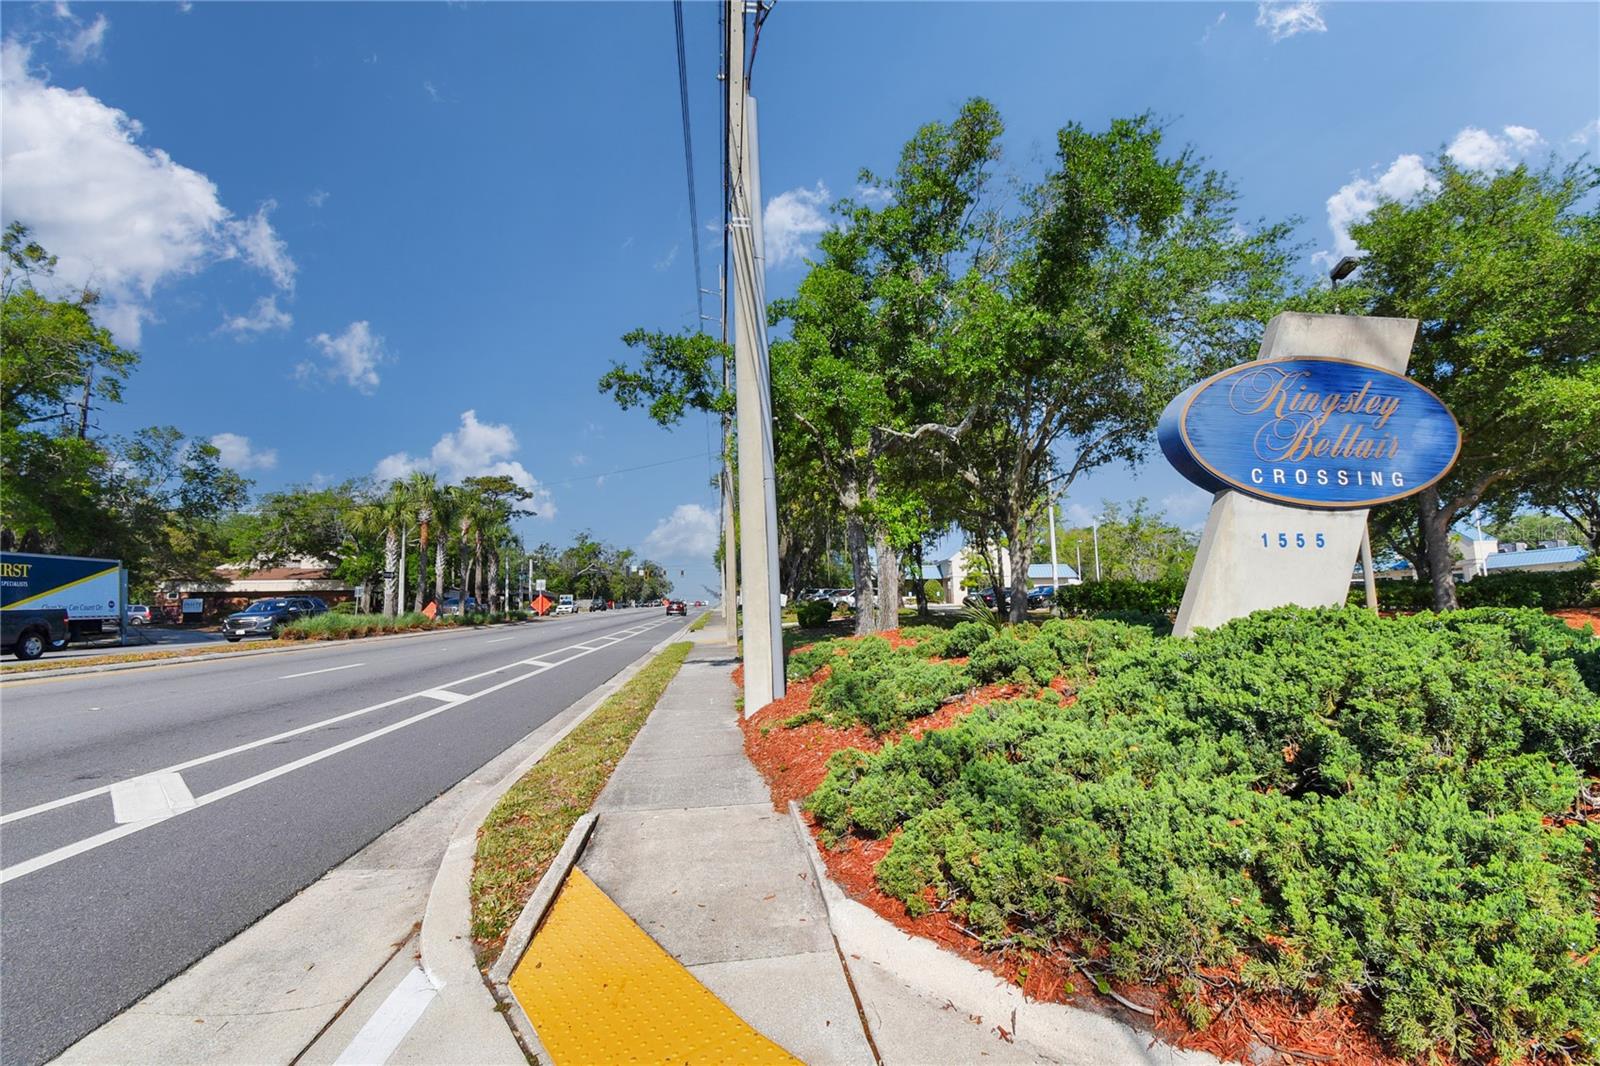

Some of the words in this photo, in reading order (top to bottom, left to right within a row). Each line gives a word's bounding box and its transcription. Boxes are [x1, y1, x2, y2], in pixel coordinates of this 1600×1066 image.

[1229, 366, 1400, 430] Kingsley
[1254, 412, 1399, 463] Bellair
[1251, 468, 1404, 487] CROSSING
[1261, 532, 1325, 548] 1555
